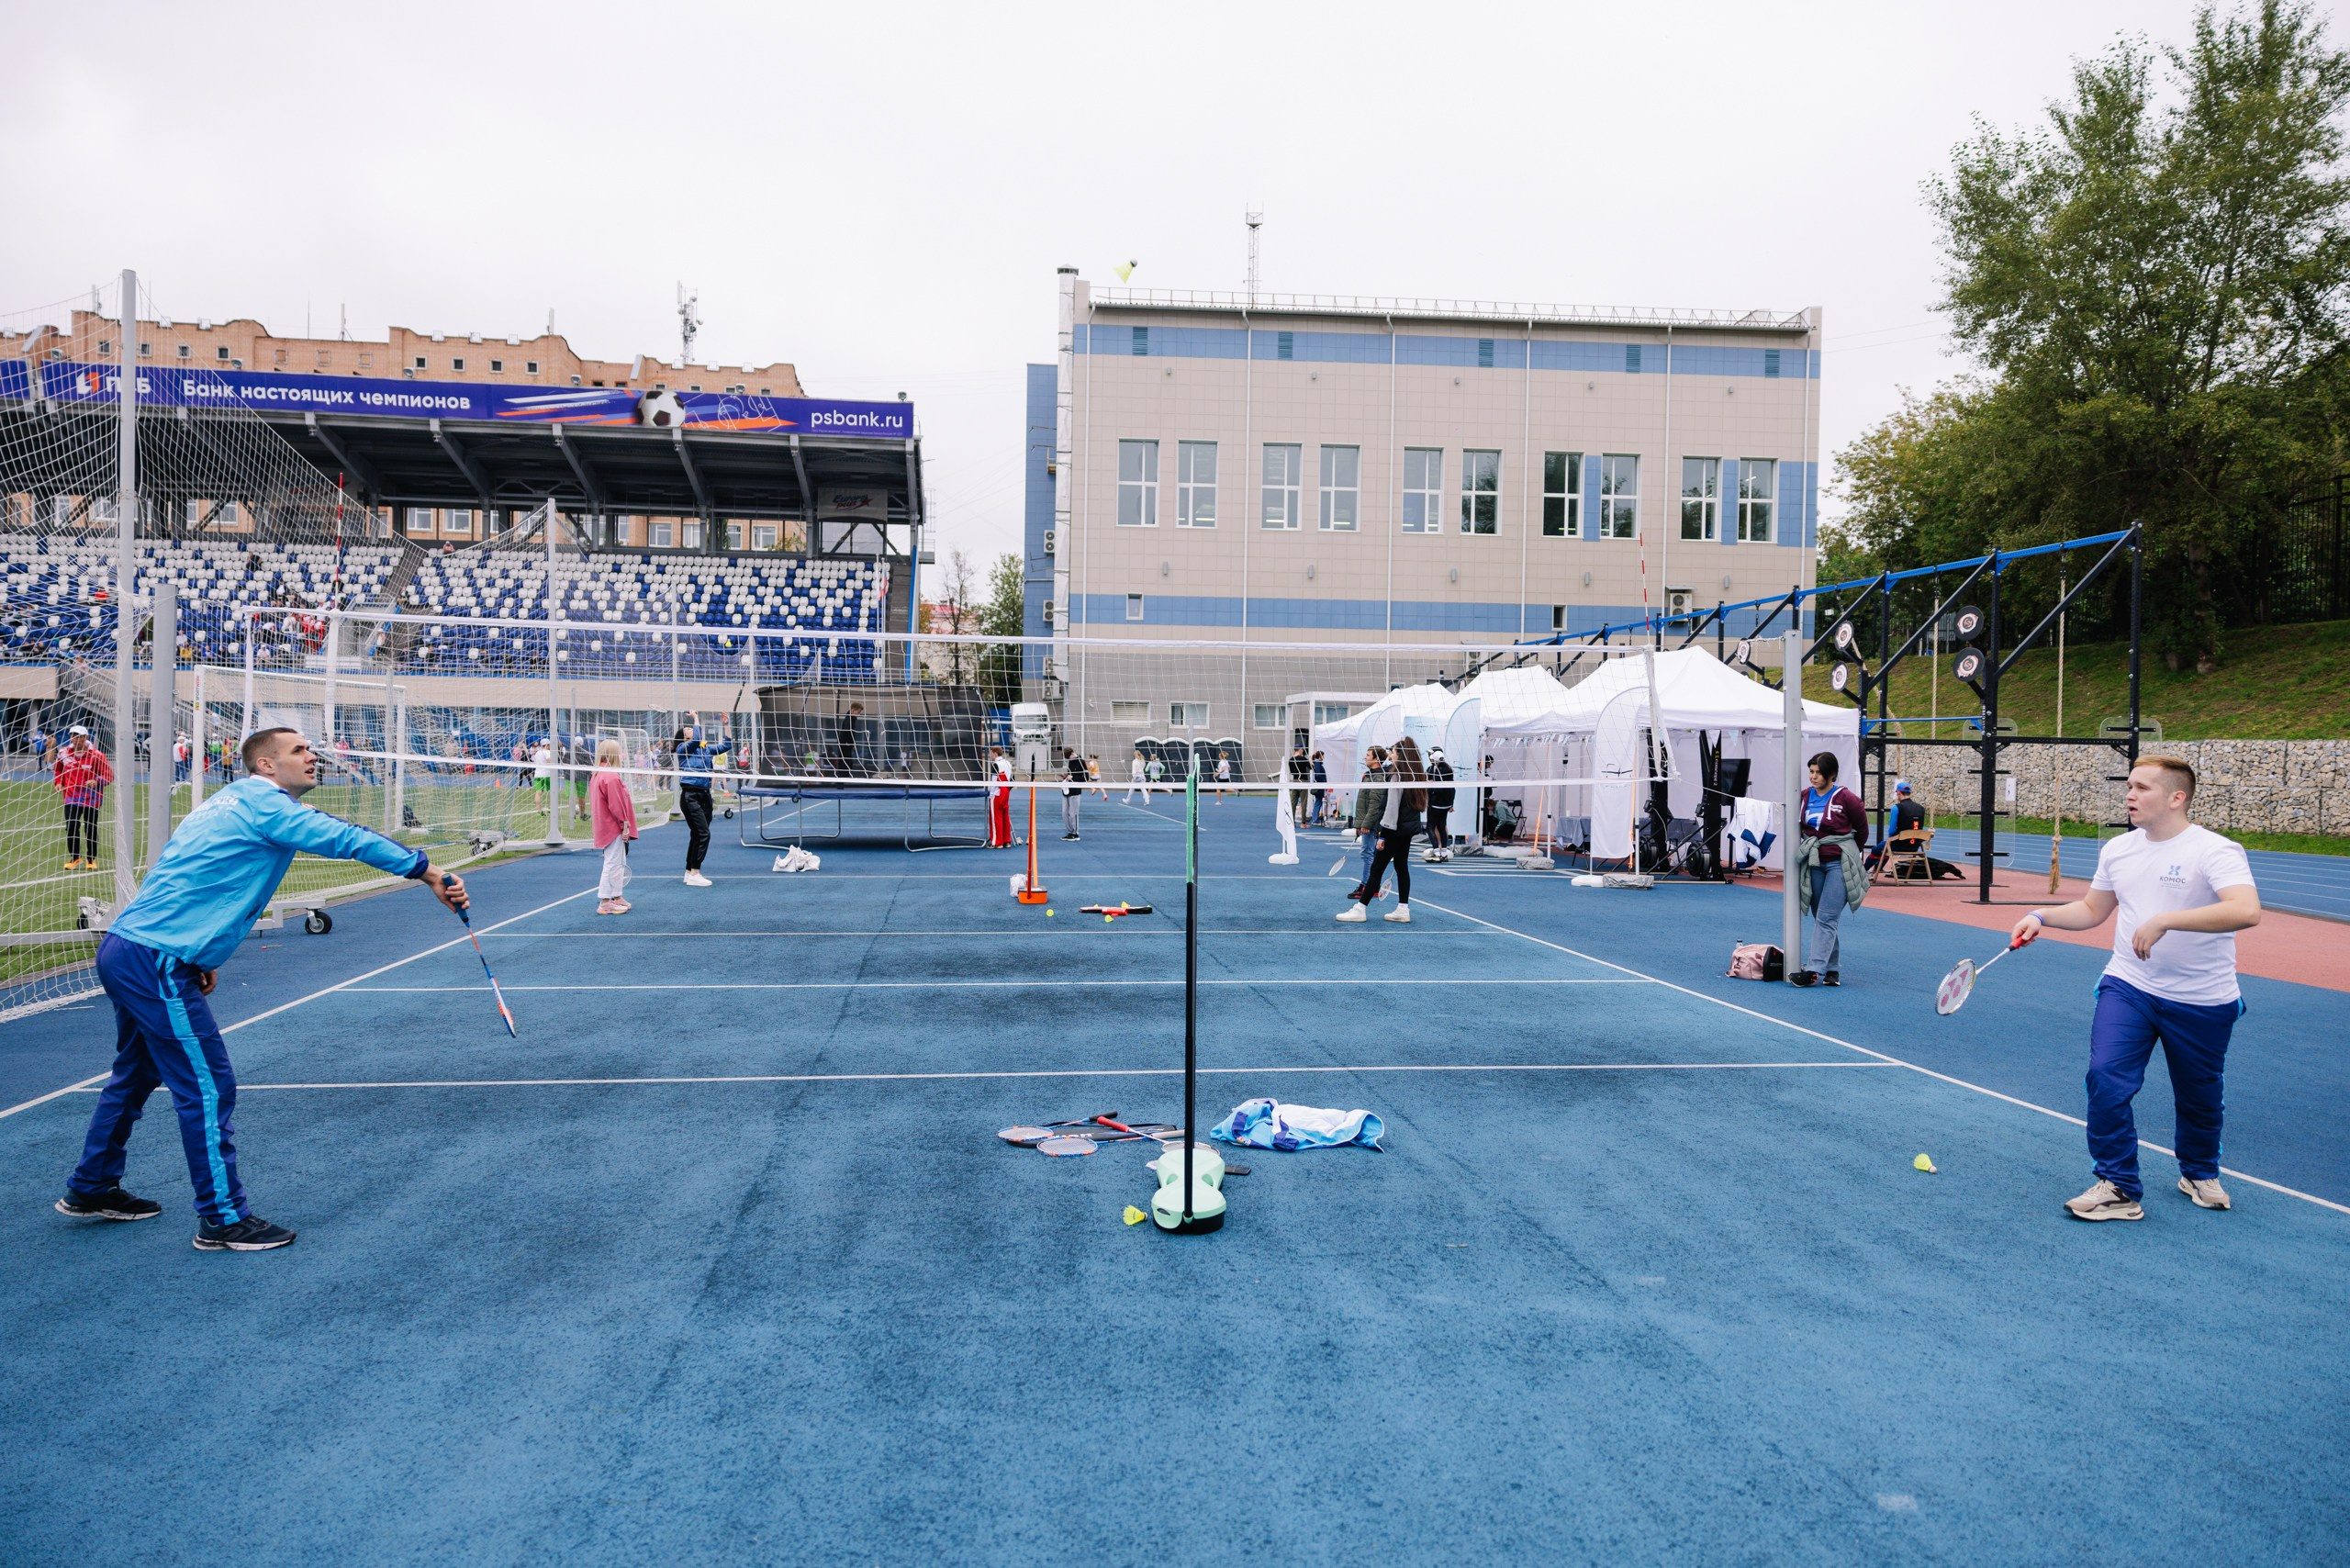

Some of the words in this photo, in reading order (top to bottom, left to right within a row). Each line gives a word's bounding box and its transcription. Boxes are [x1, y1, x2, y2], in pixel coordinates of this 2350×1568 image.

[106, 375, 151, 394] ПБ
[184, 379, 235, 398] Банк
[241, 386, 354, 405] настоящих
[359, 391, 471, 409] чемпионов
[811, 409, 903, 428] psbank.ru
